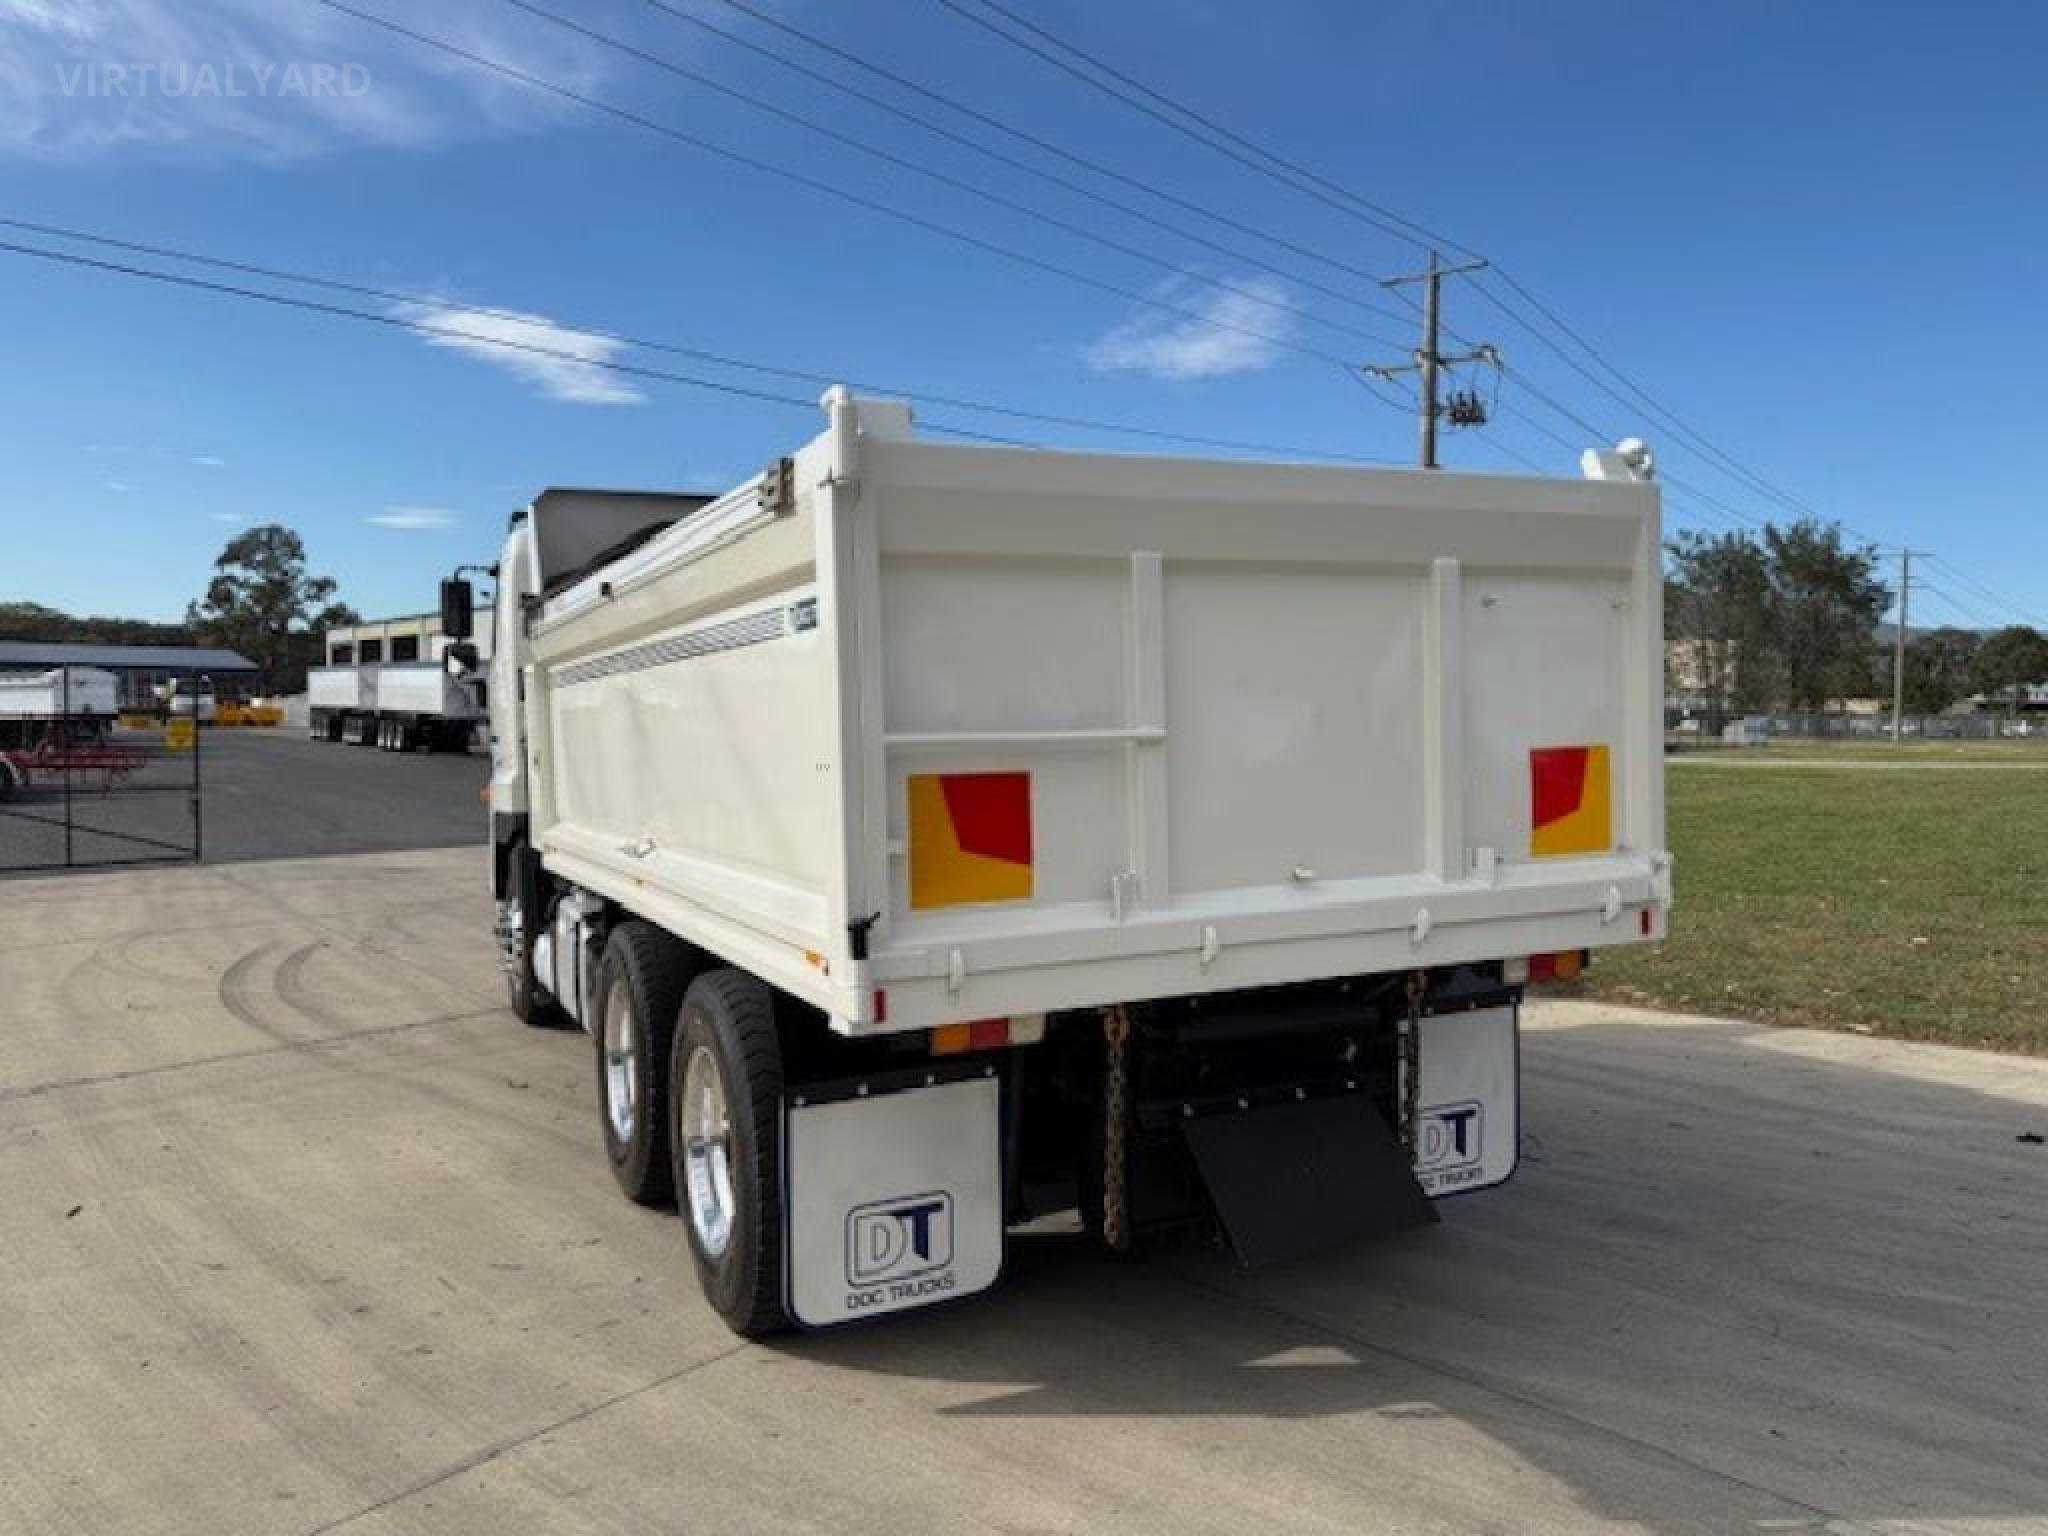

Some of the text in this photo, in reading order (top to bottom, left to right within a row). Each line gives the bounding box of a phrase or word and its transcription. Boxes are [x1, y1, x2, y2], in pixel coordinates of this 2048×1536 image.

[1417, 1108, 1477, 1162] DT
[854, 1200, 945, 1278] DT
[888, 1271, 955, 1301] TRUCKS
